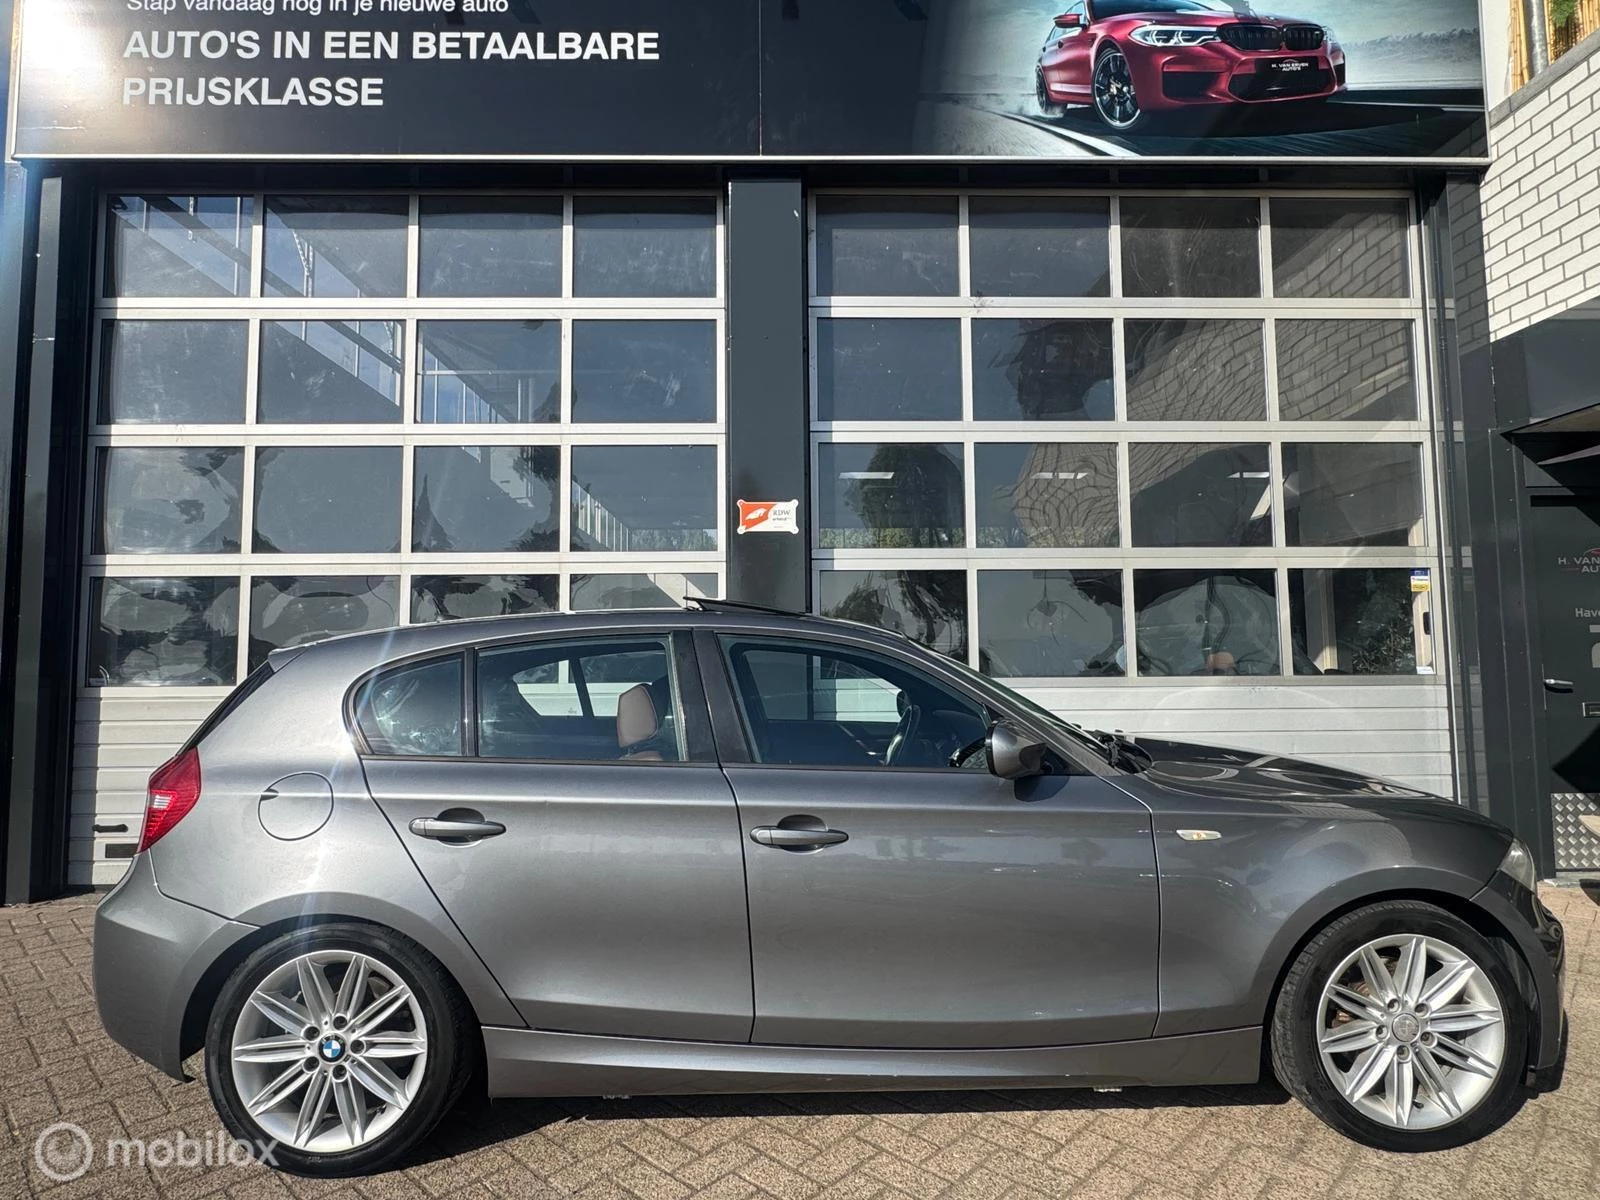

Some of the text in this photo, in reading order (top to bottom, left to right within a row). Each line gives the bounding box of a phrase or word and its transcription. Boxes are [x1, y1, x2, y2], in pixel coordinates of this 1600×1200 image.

[127, 0, 509, 15] Stap vandaag nog in je nieuwe auto
[123, 30, 660, 60] AUTO'S IN EEN BETAALBARE
[122, 77, 384, 106] PRIJSKLASSE
[1558, 557, 1570, 565] H.
[1581, 565, 1600, 573] AU
